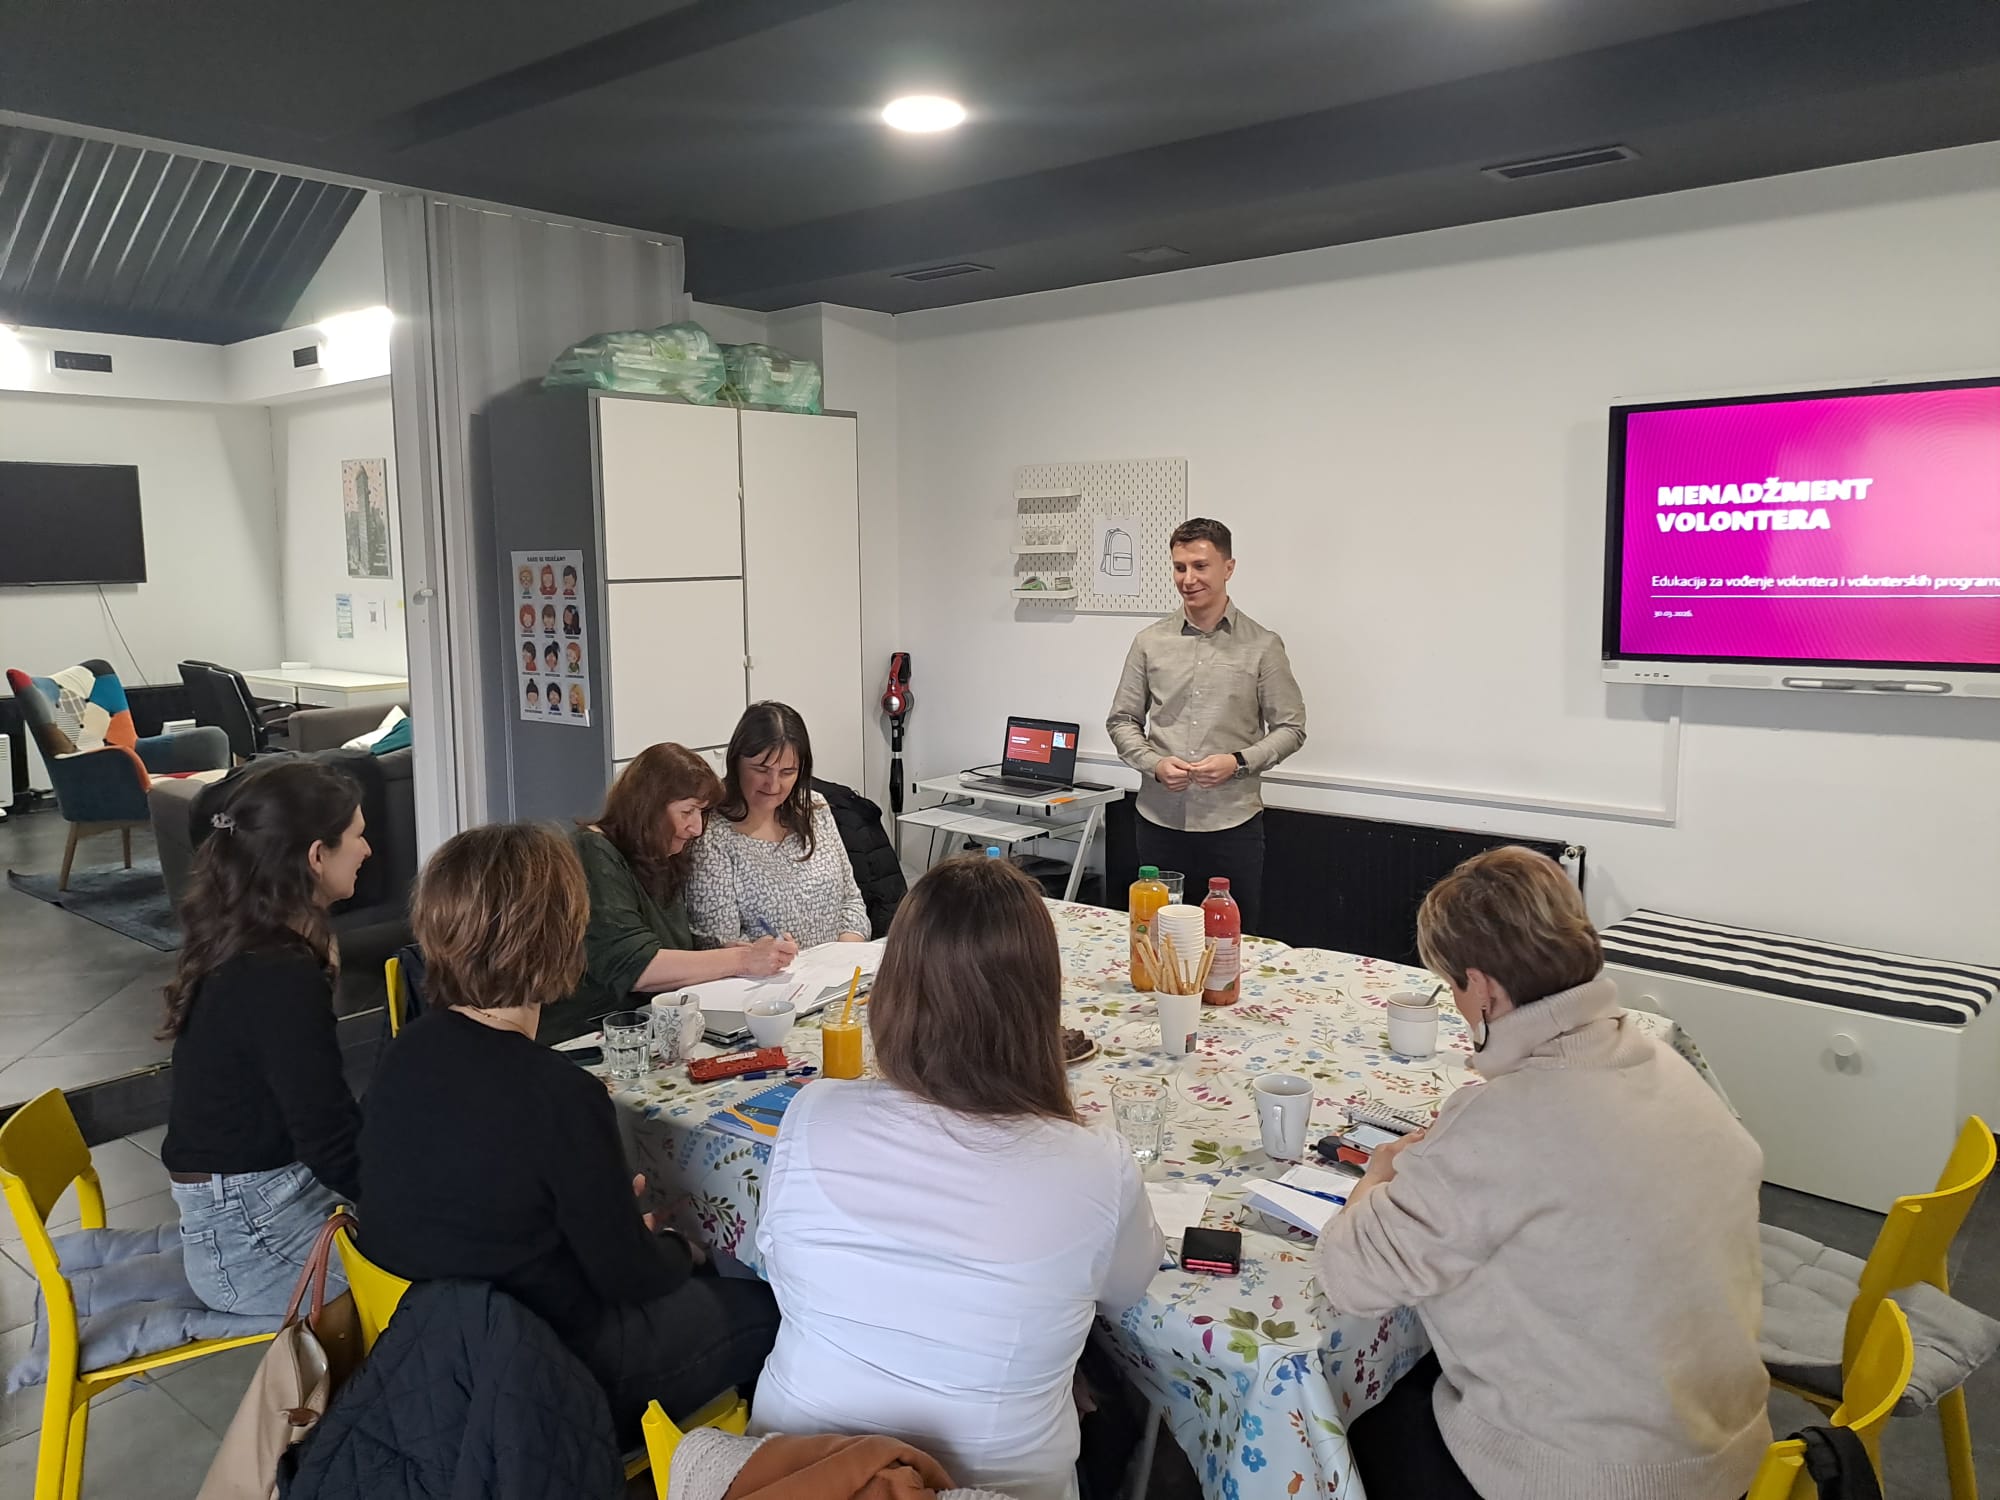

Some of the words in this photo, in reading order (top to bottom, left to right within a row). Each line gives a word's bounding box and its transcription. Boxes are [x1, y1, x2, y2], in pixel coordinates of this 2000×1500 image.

[1657, 476, 1874, 506] MENADŽMENT
[1656, 508, 1831, 532] VOLONTERA
[1651, 575, 1707, 590] Edukacija
[1709, 577, 1723, 587] za
[1725, 574, 1775, 590] vođenje
[1776, 575, 1838, 587] volontera
[1841, 576, 1846, 587] i
[1847, 574, 1932, 587] volonterskih
